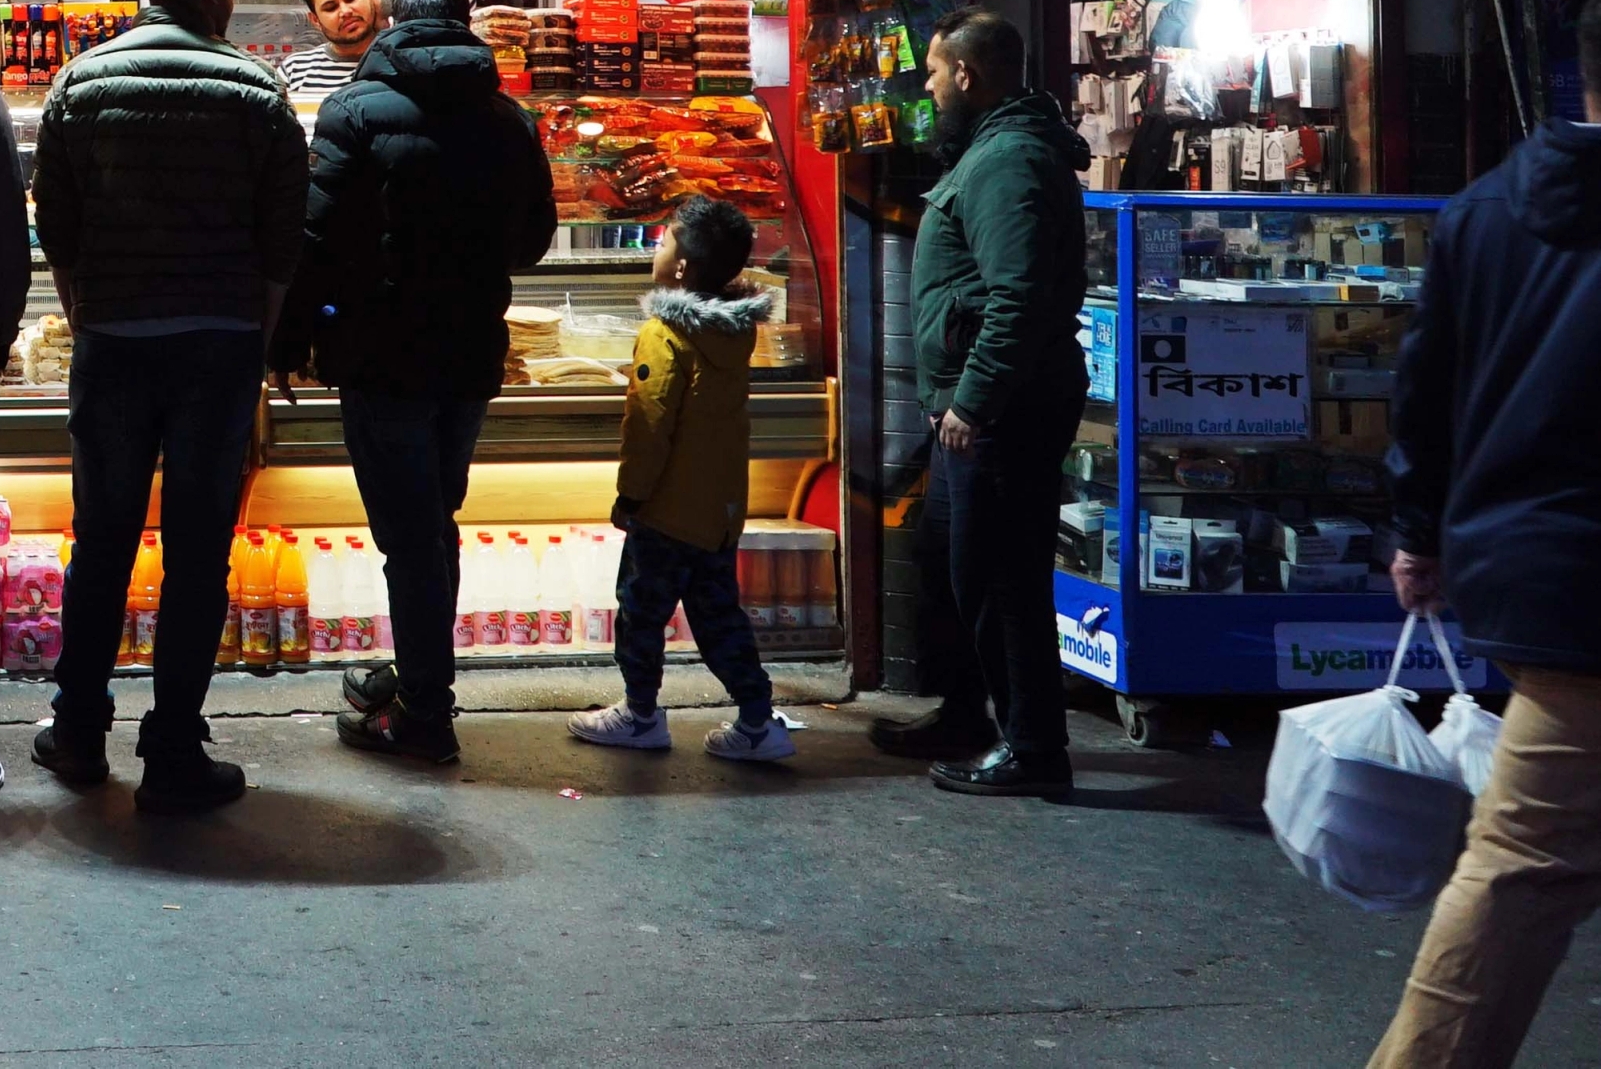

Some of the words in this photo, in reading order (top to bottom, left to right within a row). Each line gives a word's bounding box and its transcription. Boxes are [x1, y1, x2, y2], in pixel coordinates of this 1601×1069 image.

[2, 71, 28, 82] Tango
[1214, 160, 1226, 174] S9
[1145, 242, 1177, 253] SELLER
[1142, 365, 1304, 397] বিকাশ
[1140, 418, 1193, 433] Calling
[1198, 418, 1232, 432] Card
[1237, 418, 1306, 433] Available
[1291, 636, 1474, 676] Lycamobie
